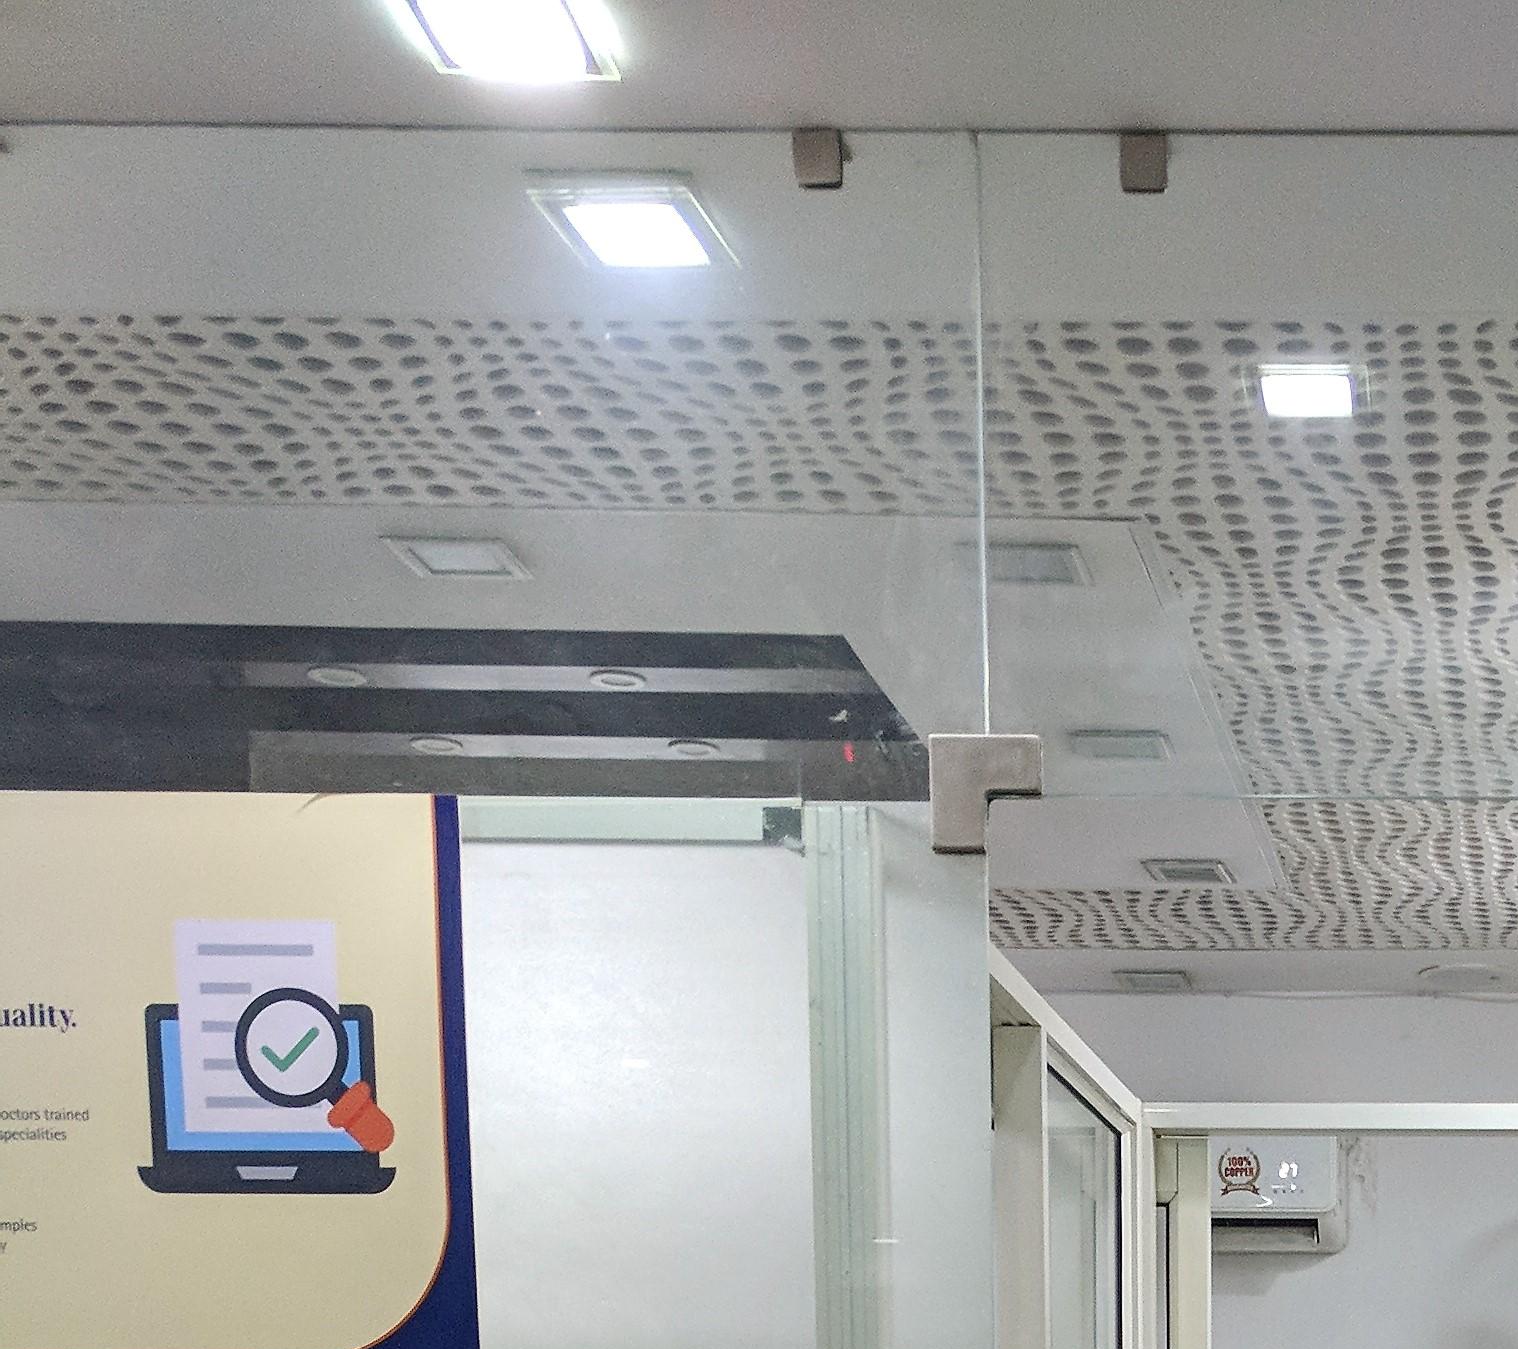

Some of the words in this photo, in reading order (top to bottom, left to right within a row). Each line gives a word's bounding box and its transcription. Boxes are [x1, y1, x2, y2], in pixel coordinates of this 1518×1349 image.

[44, 1108, 90, 1121] trained
[1227, 1156, 1252, 1168] 100%
[1224, 1167, 1255, 1178] COPPER
